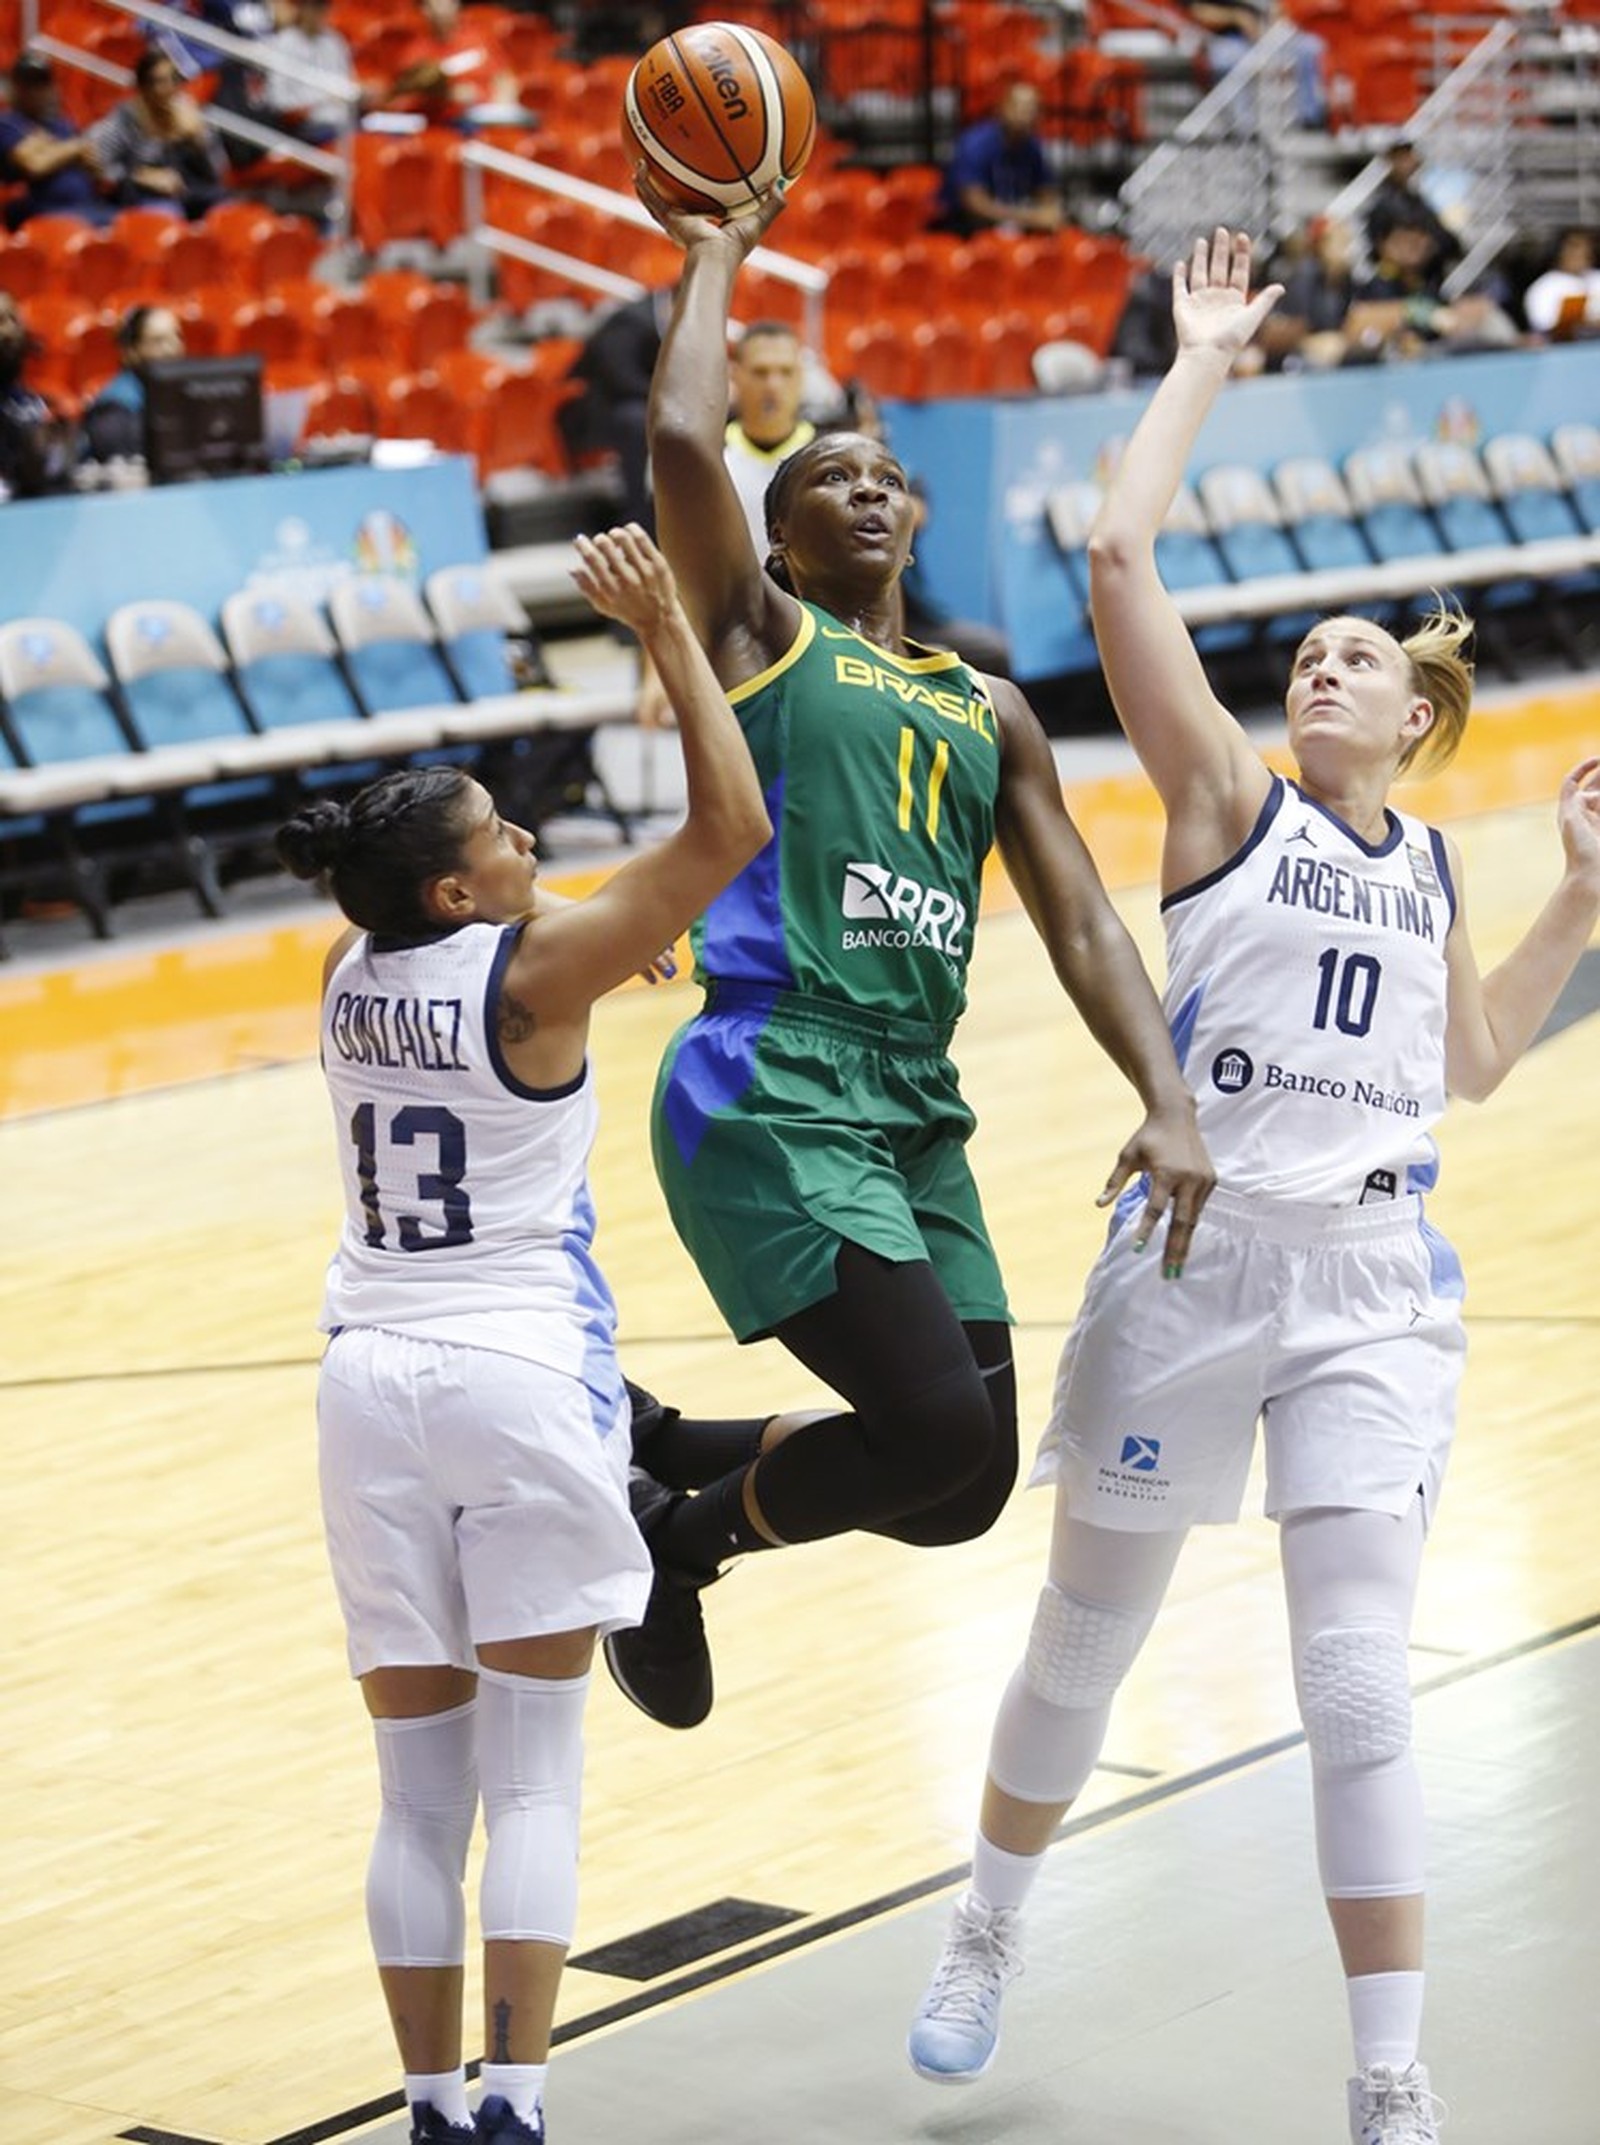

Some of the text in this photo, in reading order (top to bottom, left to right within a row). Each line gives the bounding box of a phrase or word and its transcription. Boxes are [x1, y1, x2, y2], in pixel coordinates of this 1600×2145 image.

[655, 72, 685, 114] FIBA
[835, 655, 994, 745] BRASIL
[898, 726, 949, 845] 11
[842, 928, 911, 950] BANCO
[1268, 855, 1435, 943] ARGENTINA
[331, 991, 470, 1072] GONZALEZ
[1312, 947, 1382, 1039] 10
[1264, 1063, 1347, 1100] Banco
[351, 1102, 475, 1253] 13
